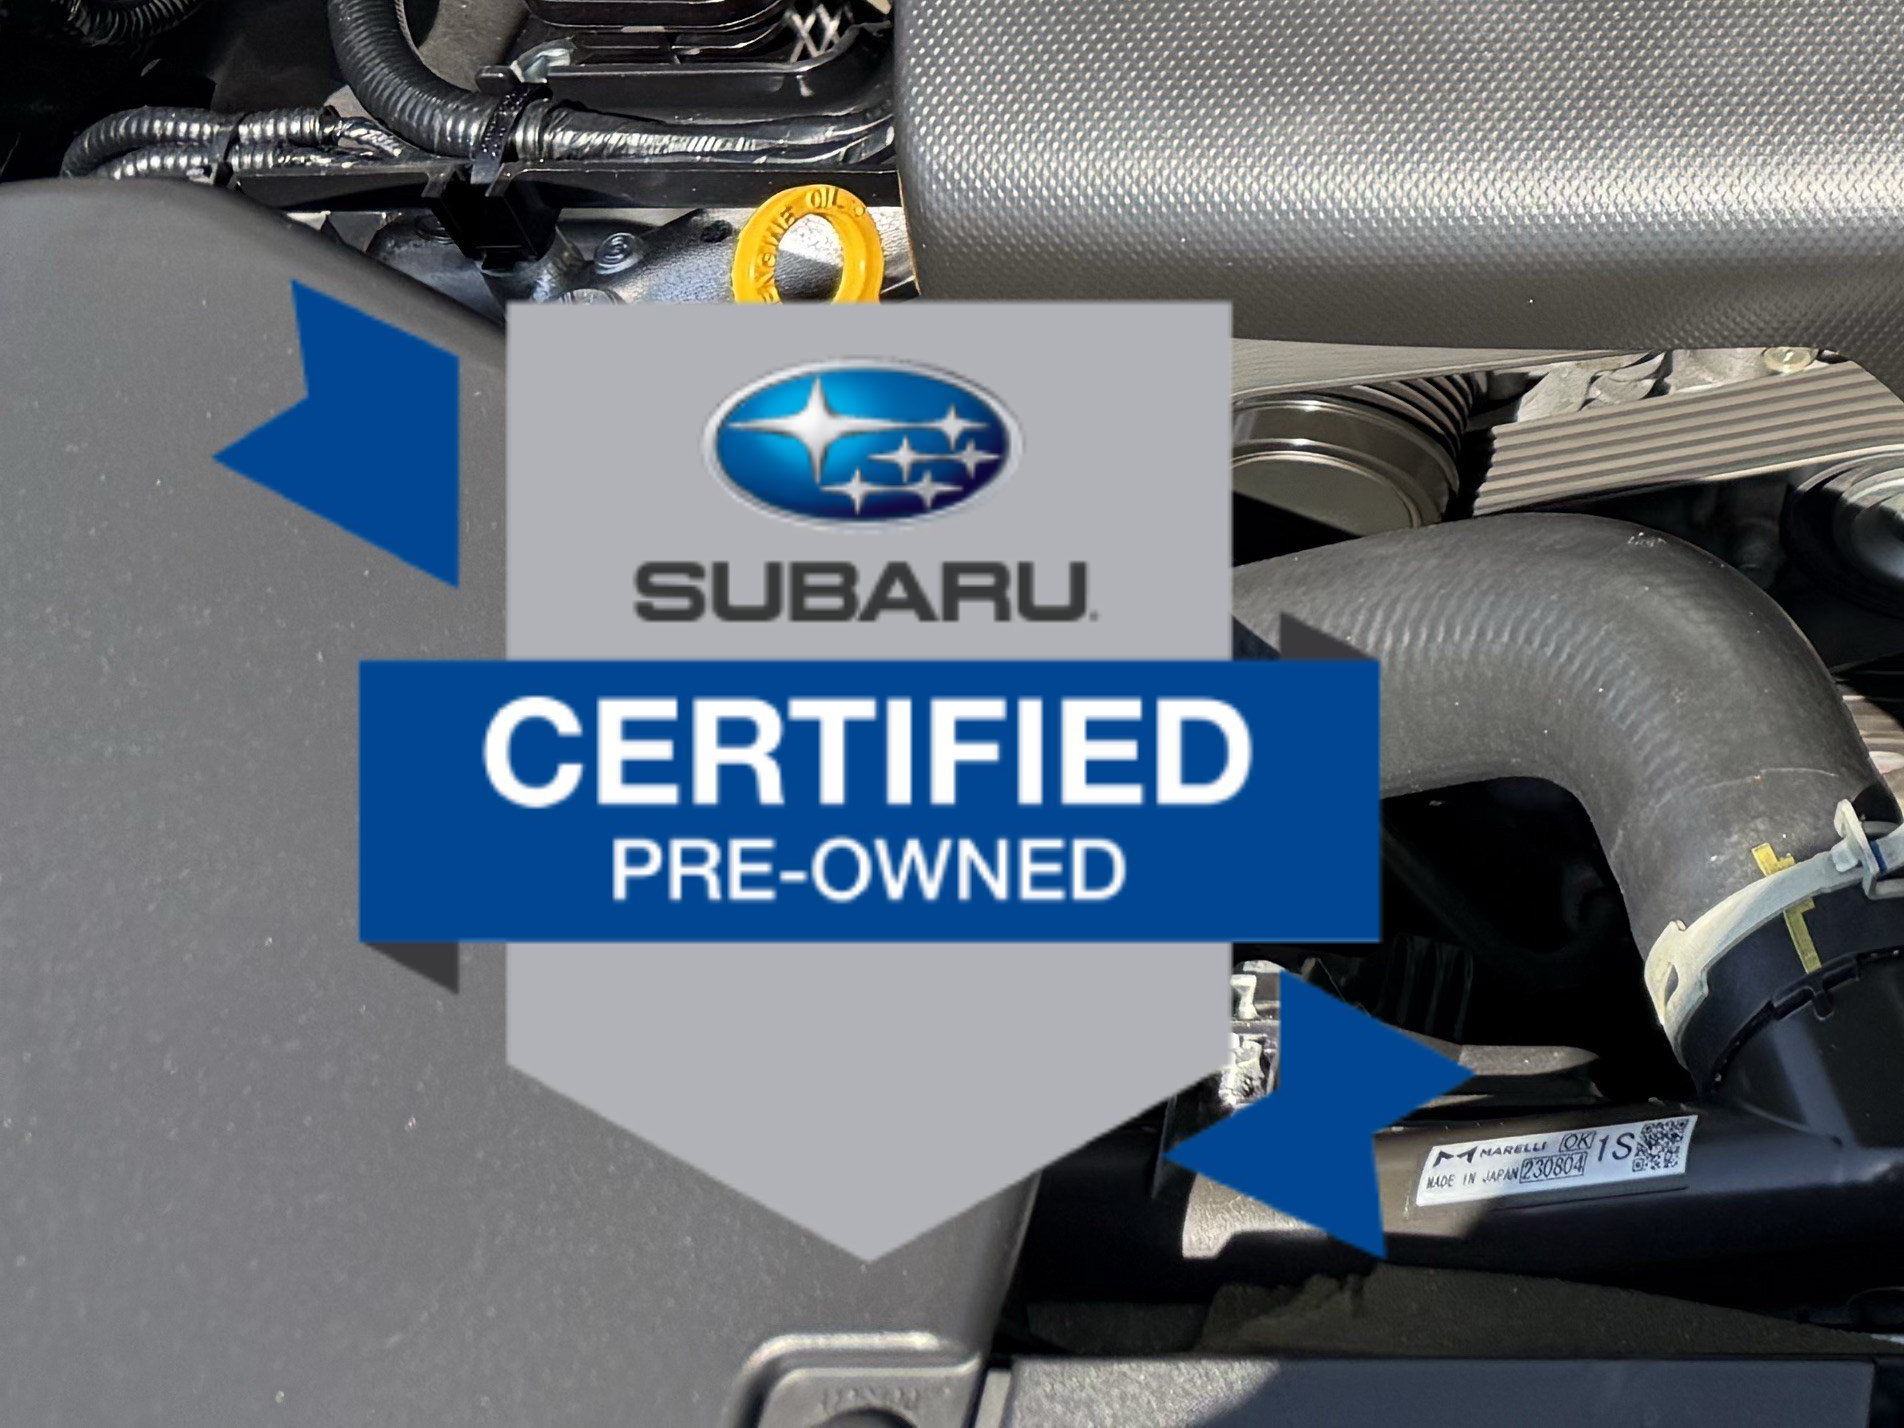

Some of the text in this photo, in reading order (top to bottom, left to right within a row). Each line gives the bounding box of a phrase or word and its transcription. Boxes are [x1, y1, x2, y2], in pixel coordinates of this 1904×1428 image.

[805, 185, 846, 210] OIL
[1479, 1132, 1635, 1162] MARELLI OK 1S
[1426, 1154, 1584, 1189] MADE IN JAPAN 230804
